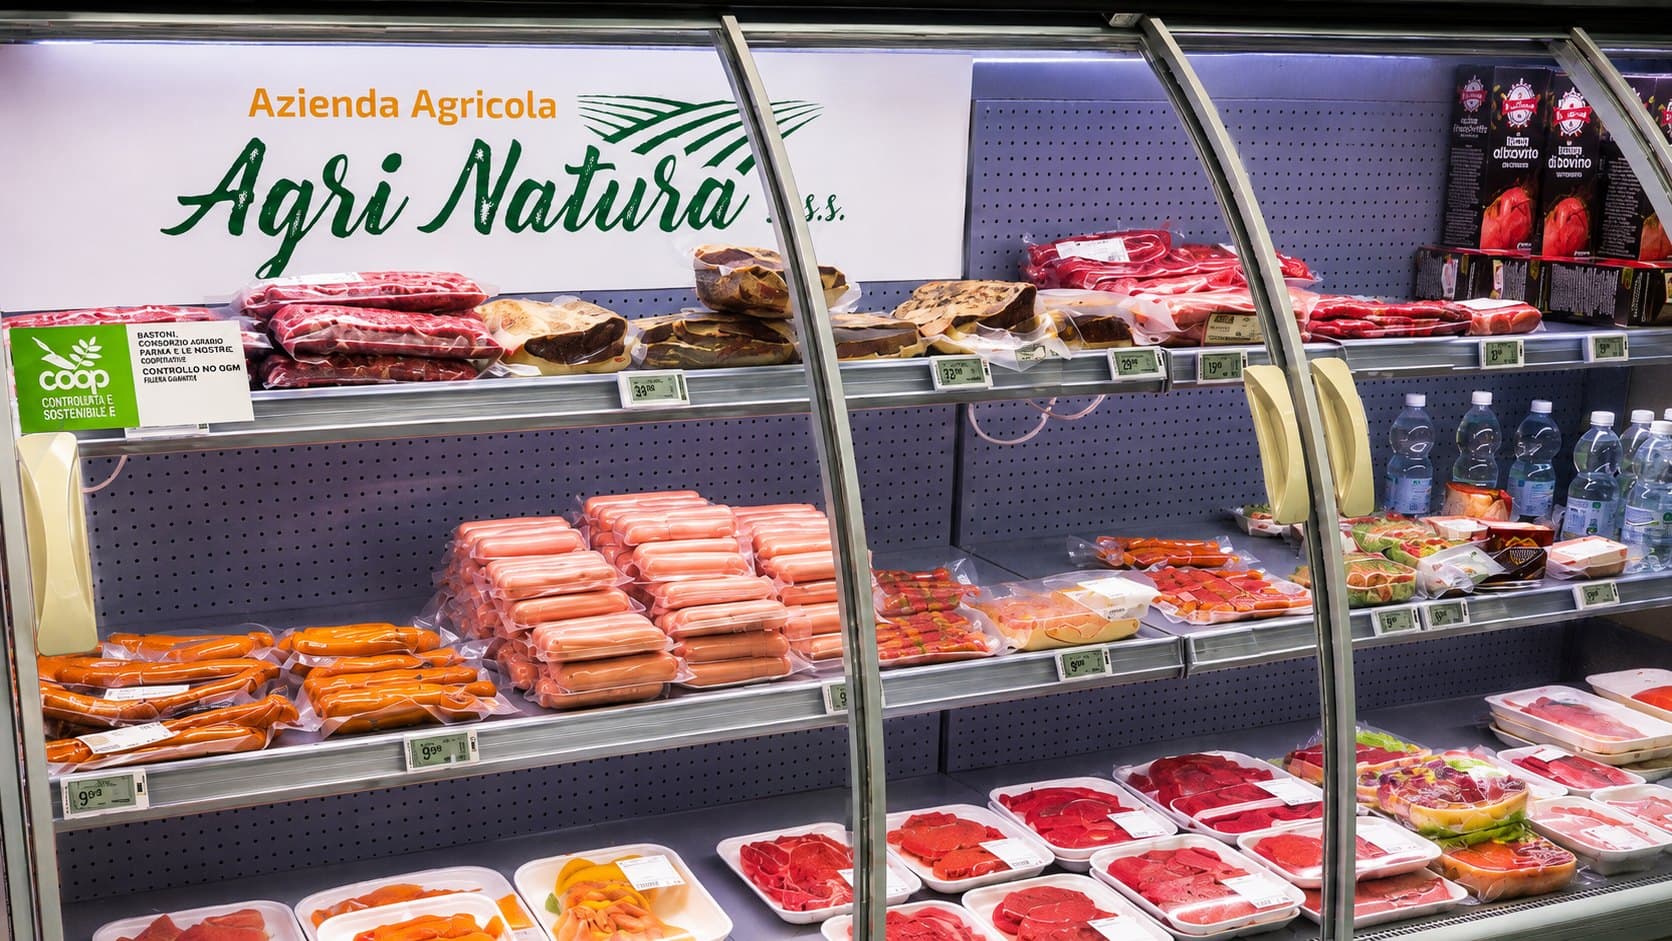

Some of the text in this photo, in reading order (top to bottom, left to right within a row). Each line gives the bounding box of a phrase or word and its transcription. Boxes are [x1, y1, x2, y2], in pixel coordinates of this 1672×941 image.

[249, 88, 557, 126] Azienda Agricola
[161, 138, 408, 279] Agri
[419, 137, 749, 234] Natura
[39, 369, 110, 396] coop
[142, 365, 200, 375] CONTROLLO
[203, 364, 217, 373] NO
[43, 407, 107, 421] SOSTENIBILE
